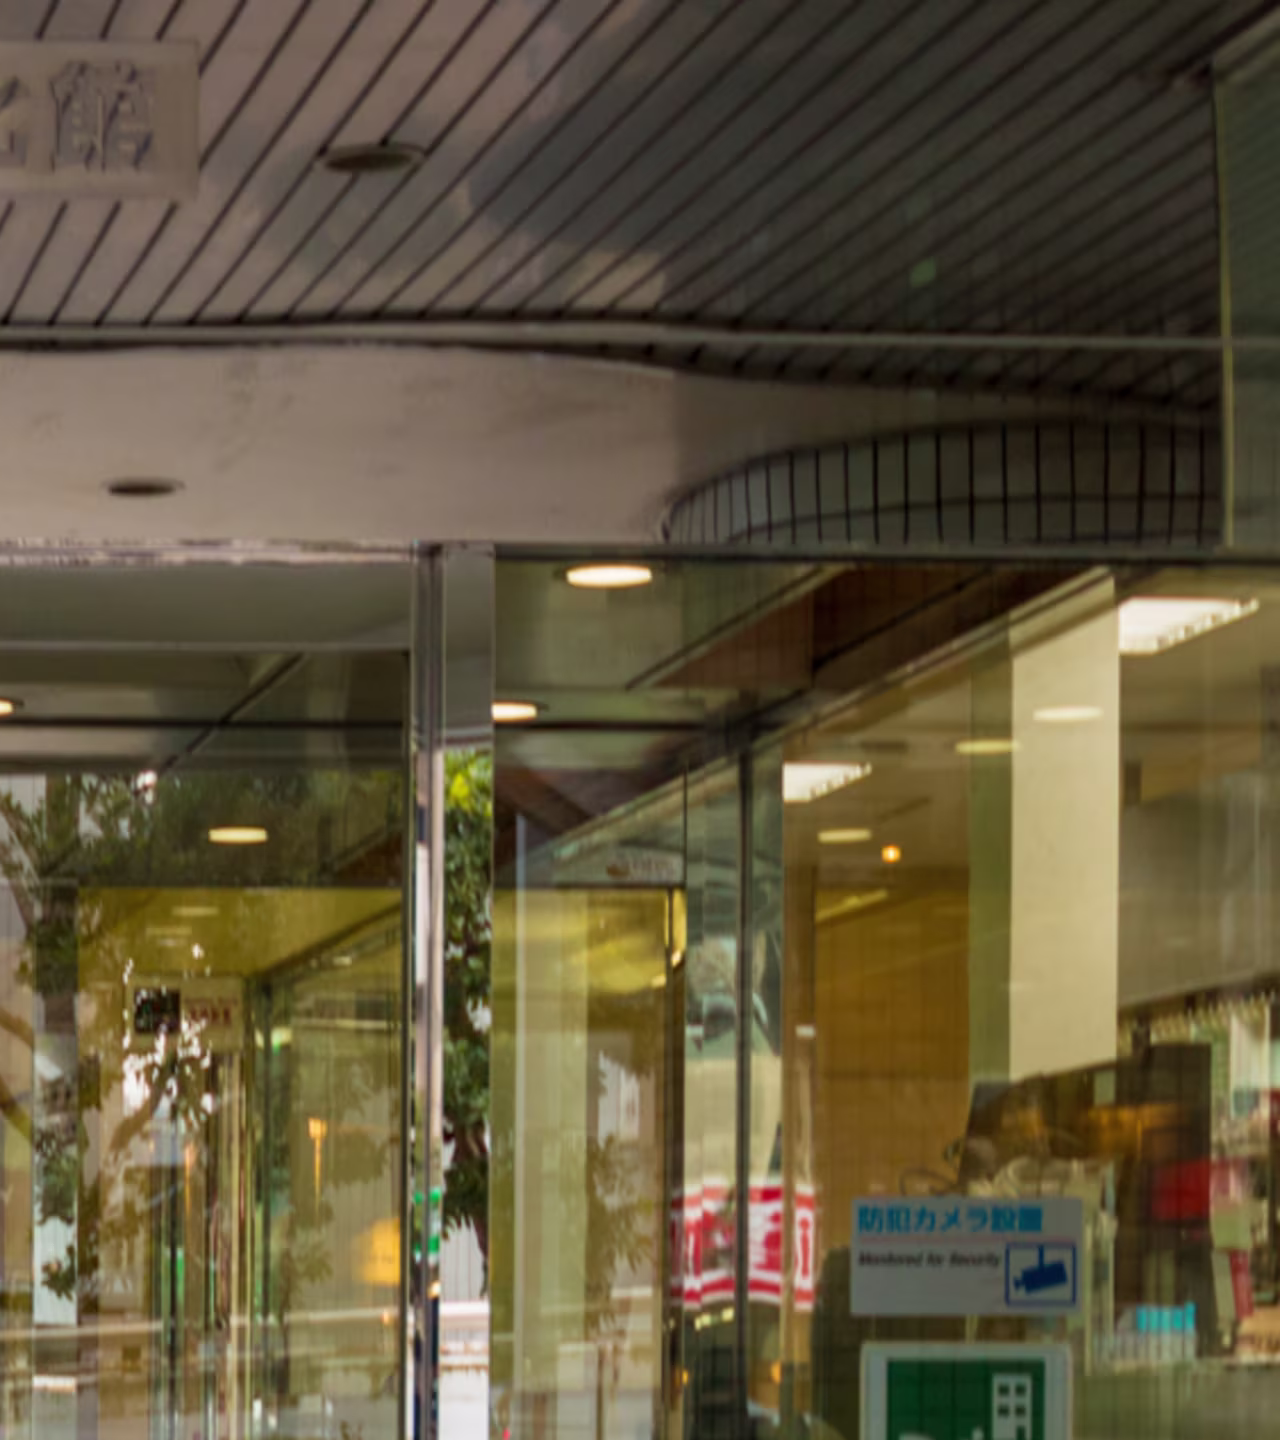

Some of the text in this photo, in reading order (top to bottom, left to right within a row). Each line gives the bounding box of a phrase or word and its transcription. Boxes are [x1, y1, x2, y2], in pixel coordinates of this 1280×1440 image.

[858, 1205, 1043, 1233] 防犯カメラ設置
